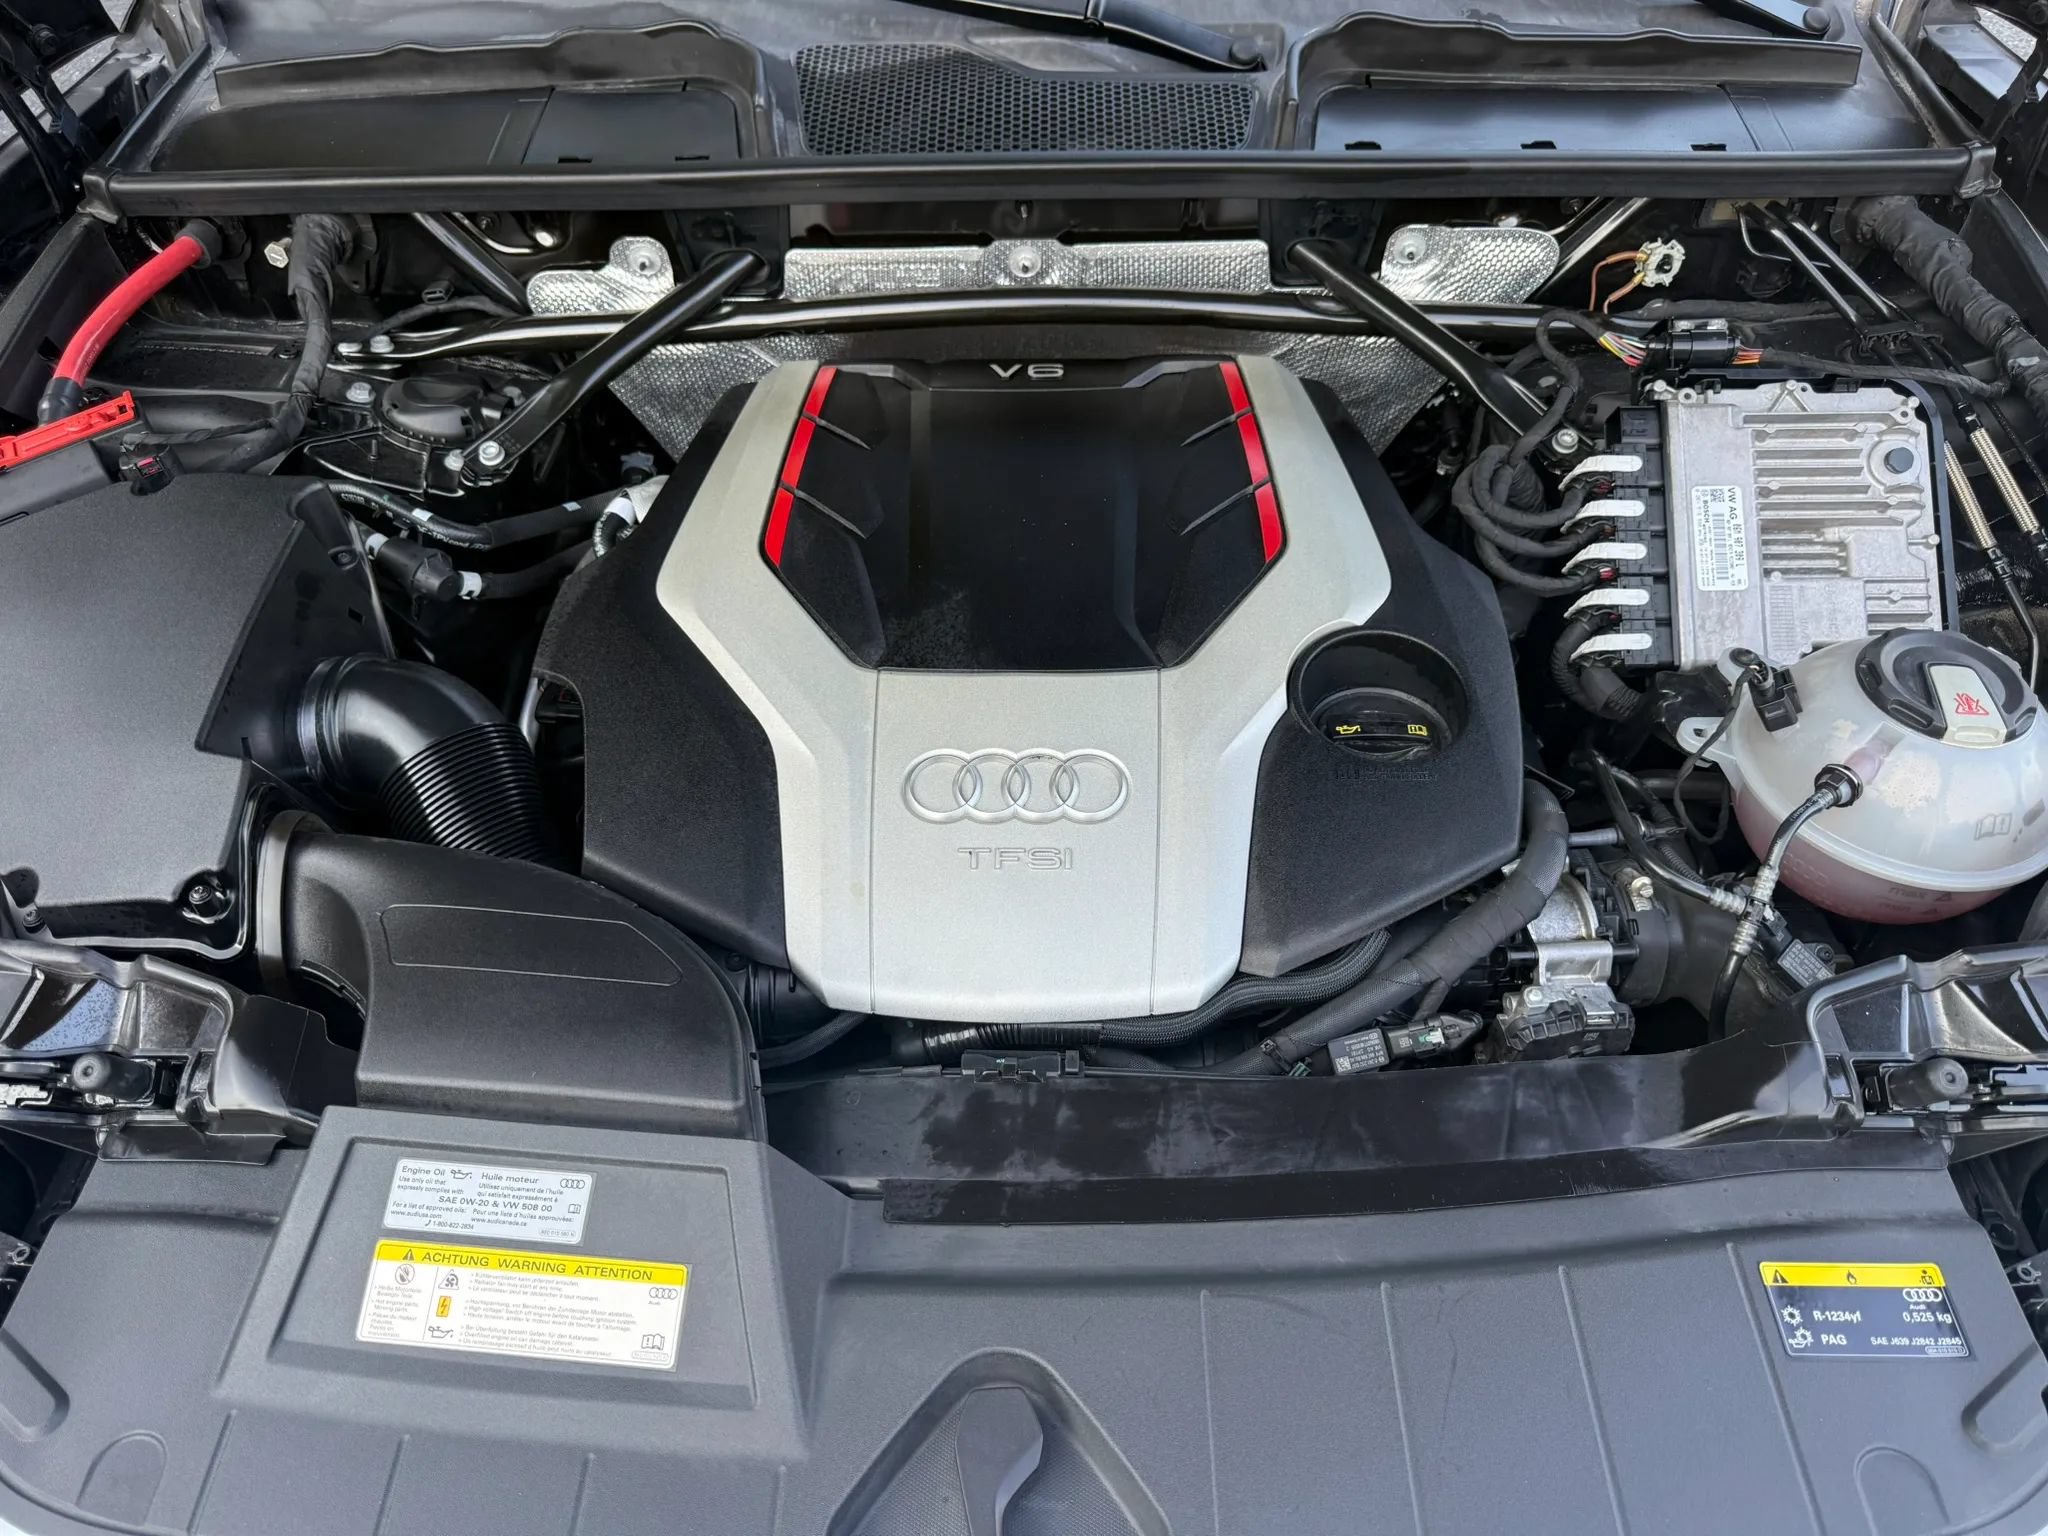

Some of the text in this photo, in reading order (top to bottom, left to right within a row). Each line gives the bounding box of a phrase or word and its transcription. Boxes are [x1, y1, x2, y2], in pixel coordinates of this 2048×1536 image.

[989, 362, 1065, 381] V6
[1728, 488, 1736, 503] VW
[1702, 500, 1710, 523] BOSCH
[1729, 506, 1737, 520] AG
[958, 846, 1074, 871] TFSI
[402, 1166, 445, 1176] Engine Oil
[482, 1172, 539, 1184] Huile moteur
[439, 1196, 458, 1204] SAE
[460, 1197, 489, 1207] 0W-20
[503, 1201, 520, 1209] VW
[541, 1204, 552, 1212] 00
[422, 1252, 652, 1280] ACHTUNG WARNING ATTENTION
[1813, 1310, 1862, 1323] R-1234yf
[1902, 1311, 1952, 1325] 0,525 kg
[1821, 1334, 1847, 1345] PAG
[1870, 1336, 1889, 1345] SAE
[1912, 1337, 1935, 1346] J2842
[1937, 1337, 1961, 1345] J2845
